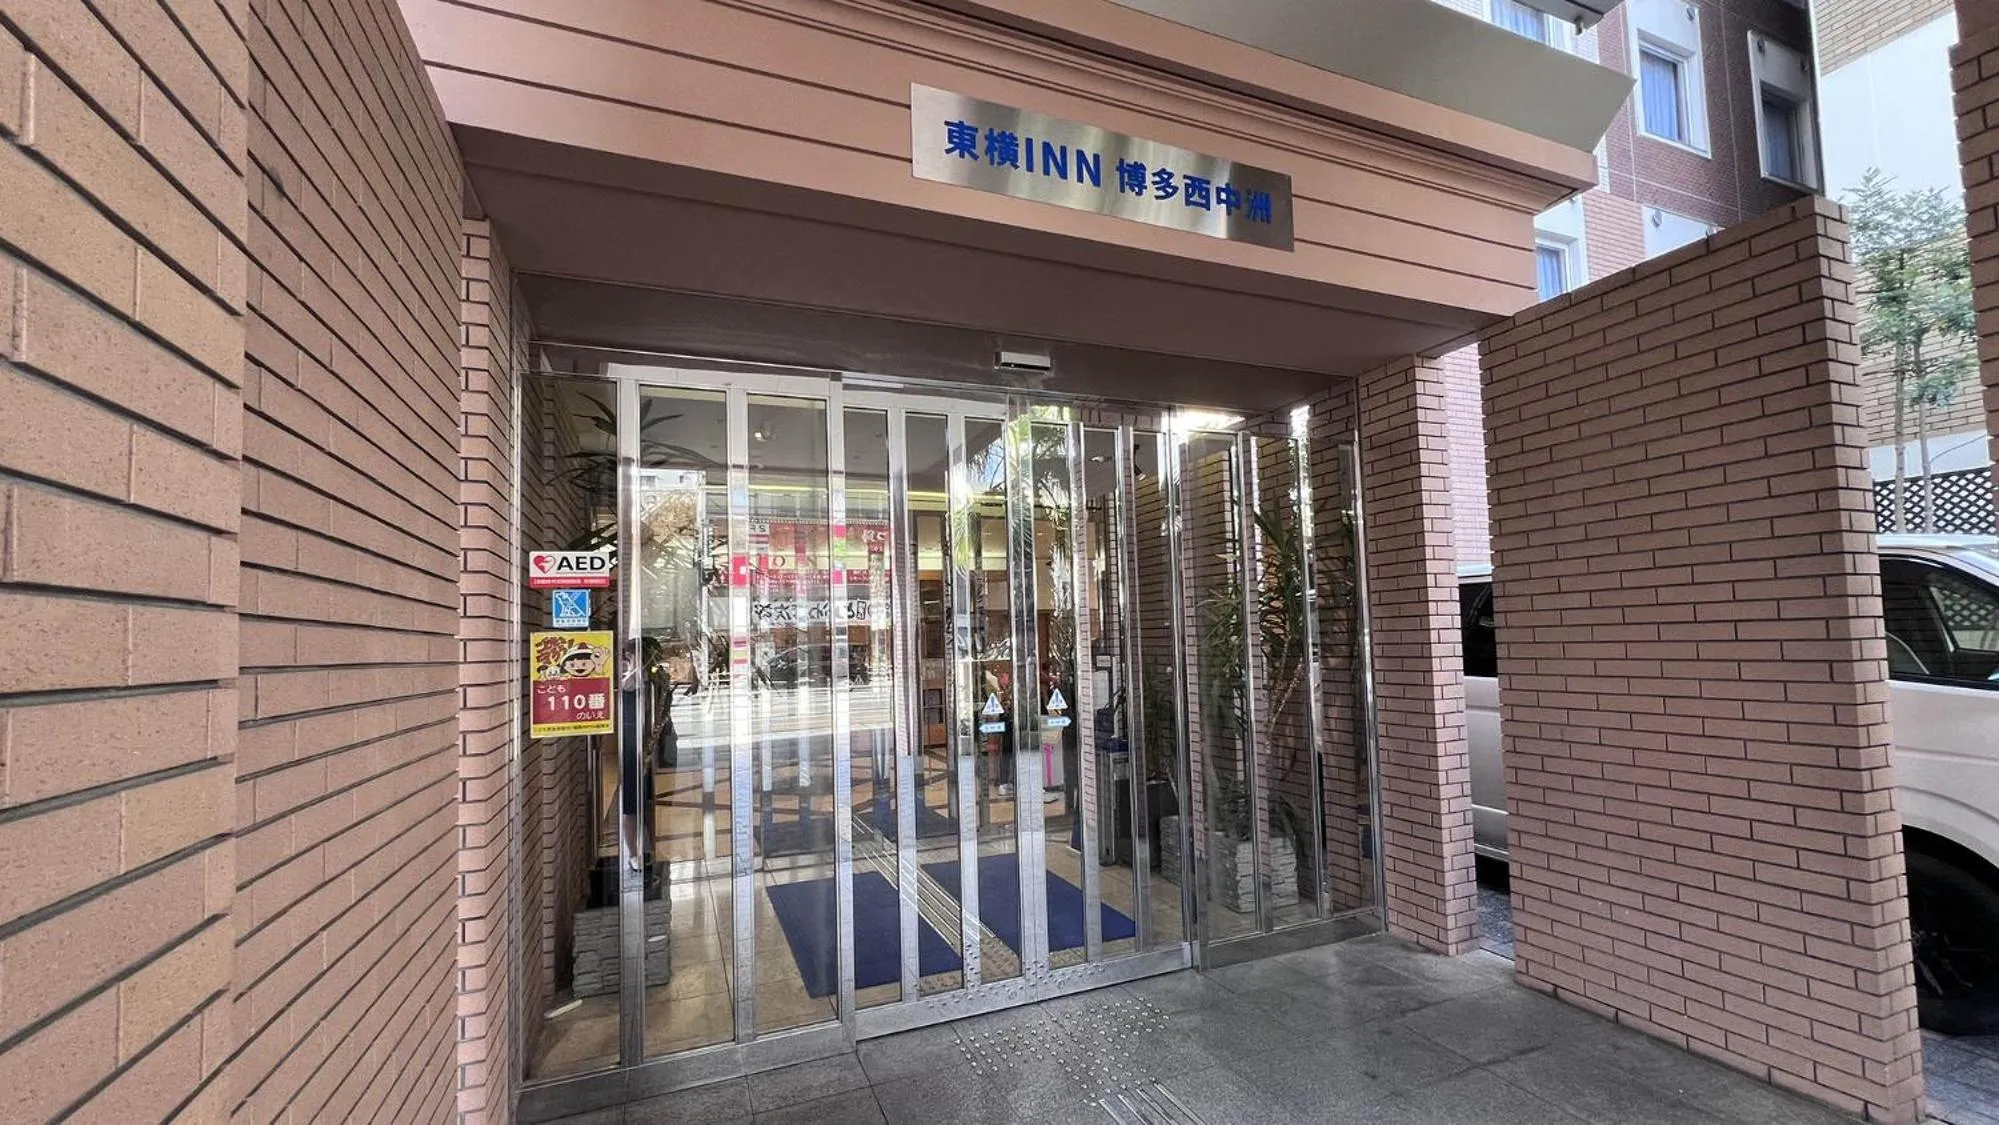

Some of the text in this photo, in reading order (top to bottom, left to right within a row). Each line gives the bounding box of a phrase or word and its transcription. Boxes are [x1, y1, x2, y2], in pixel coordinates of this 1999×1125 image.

[944, 119, 1273, 224] 東横INN 博多西中洲
[556, 555, 606, 571] AED
[537, 684, 566, 694] こども
[547, 692, 606, 711] 110番
[576, 711, 606, 720] のいえ
